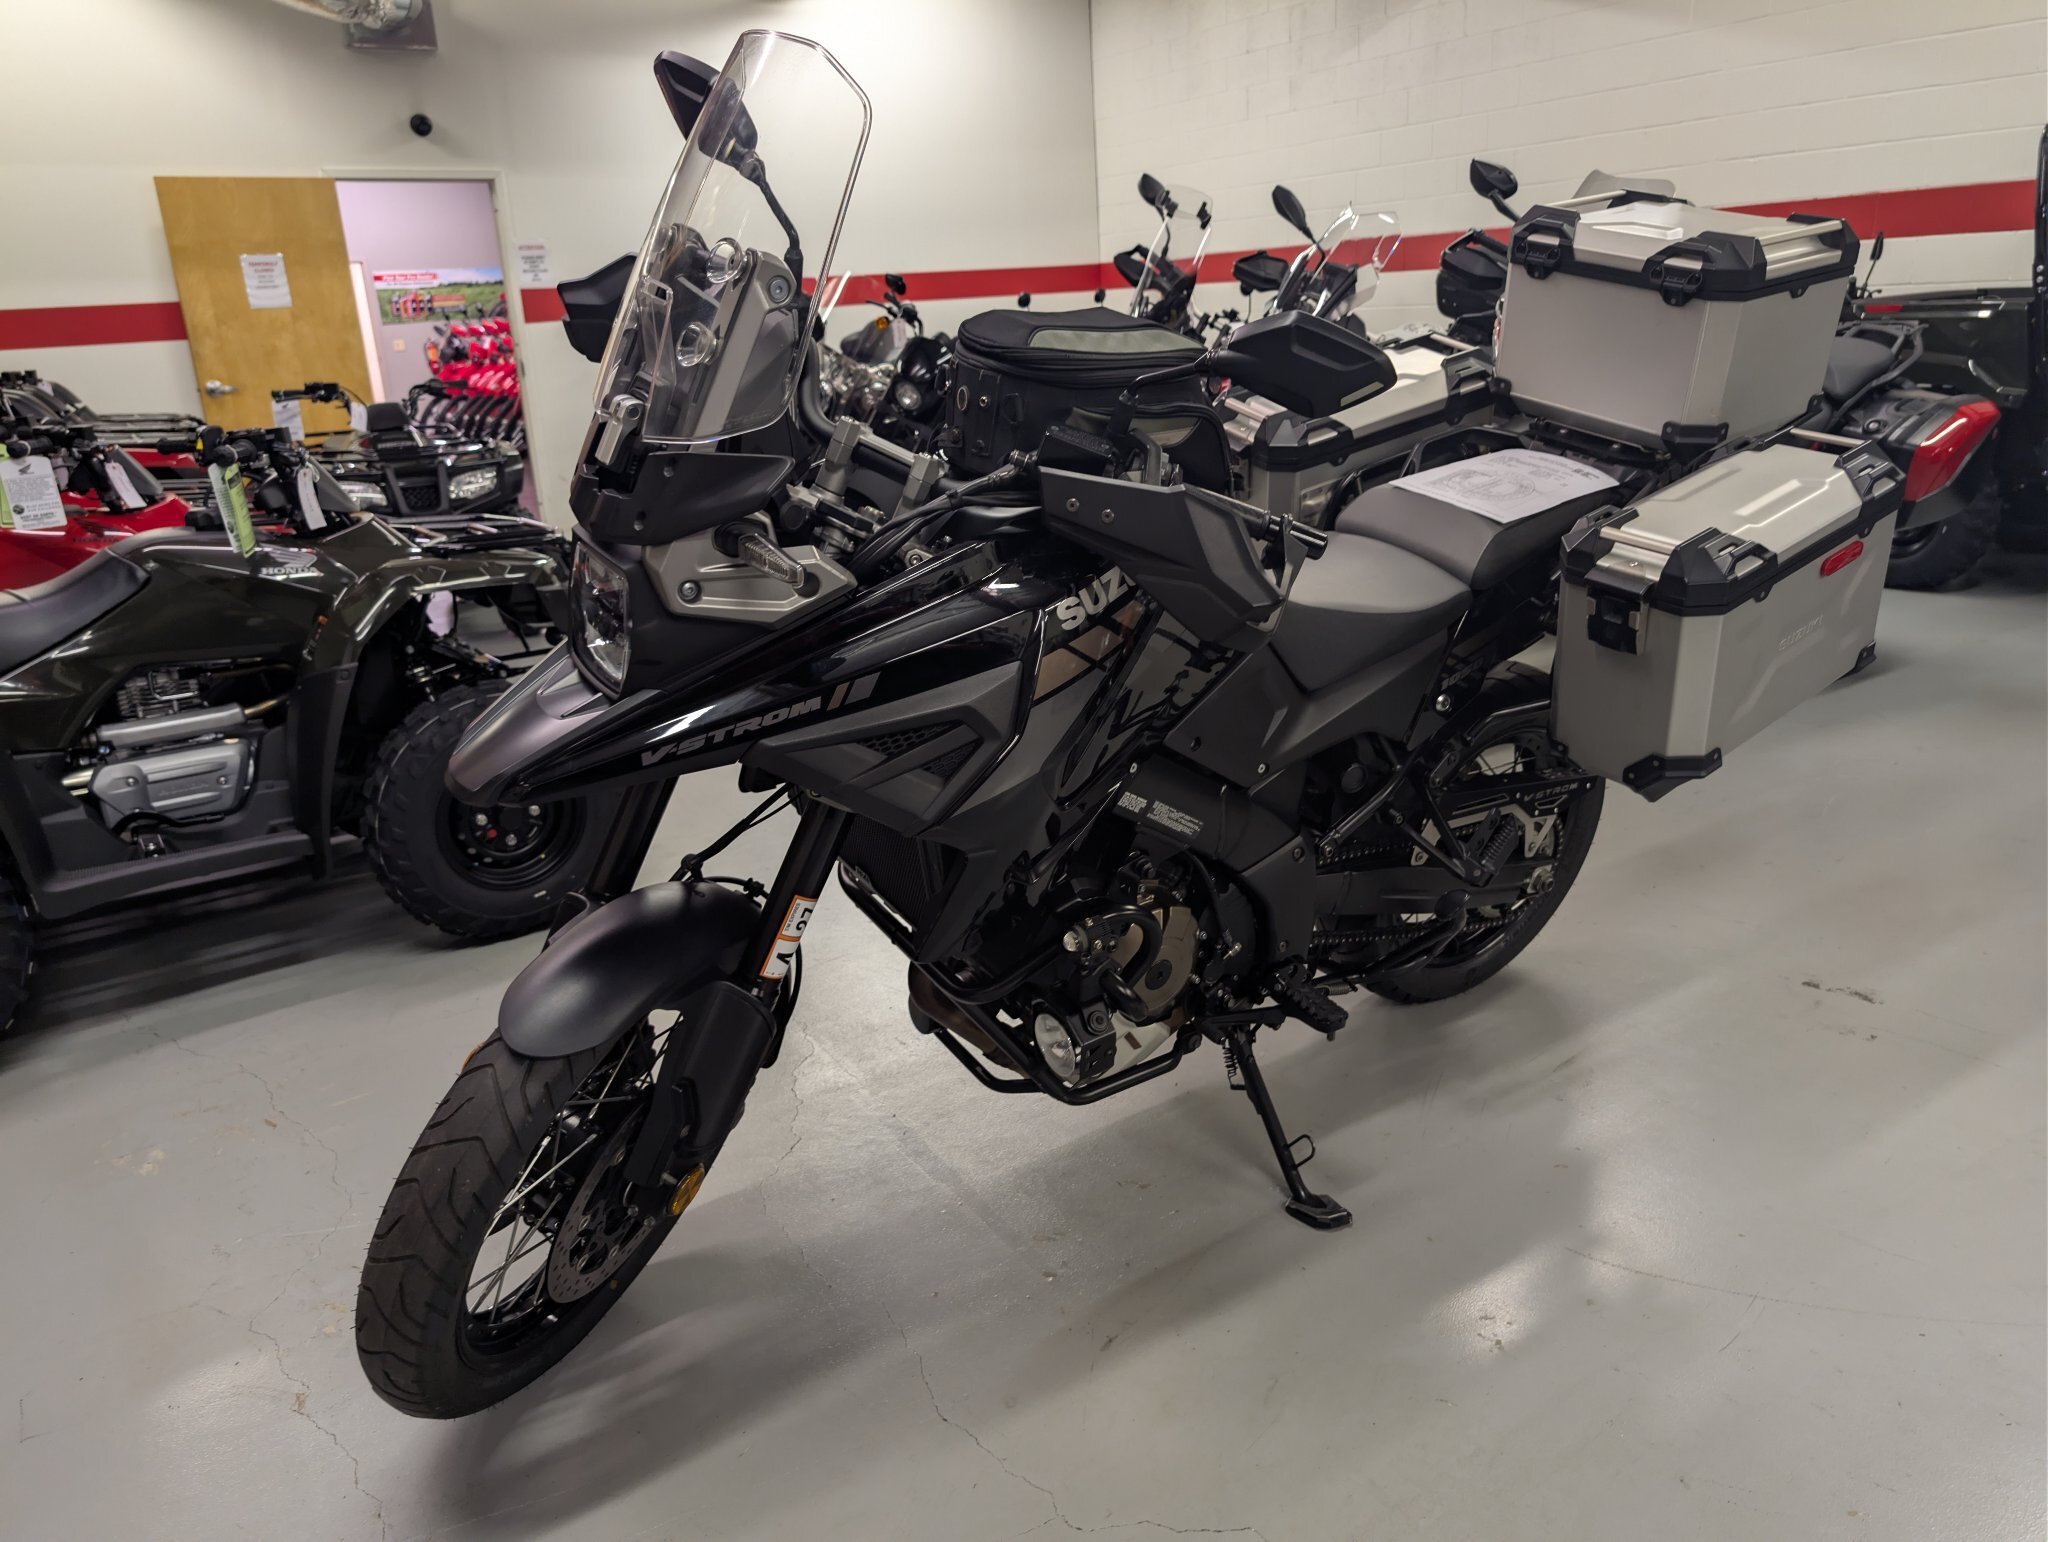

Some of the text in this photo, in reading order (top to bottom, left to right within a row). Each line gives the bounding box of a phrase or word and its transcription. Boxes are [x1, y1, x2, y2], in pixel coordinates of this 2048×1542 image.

[260, 566, 318, 575] HONDA
[1056, 565, 1136, 631] SUZ
[1778, 614, 1824, 651] SUZUKI
